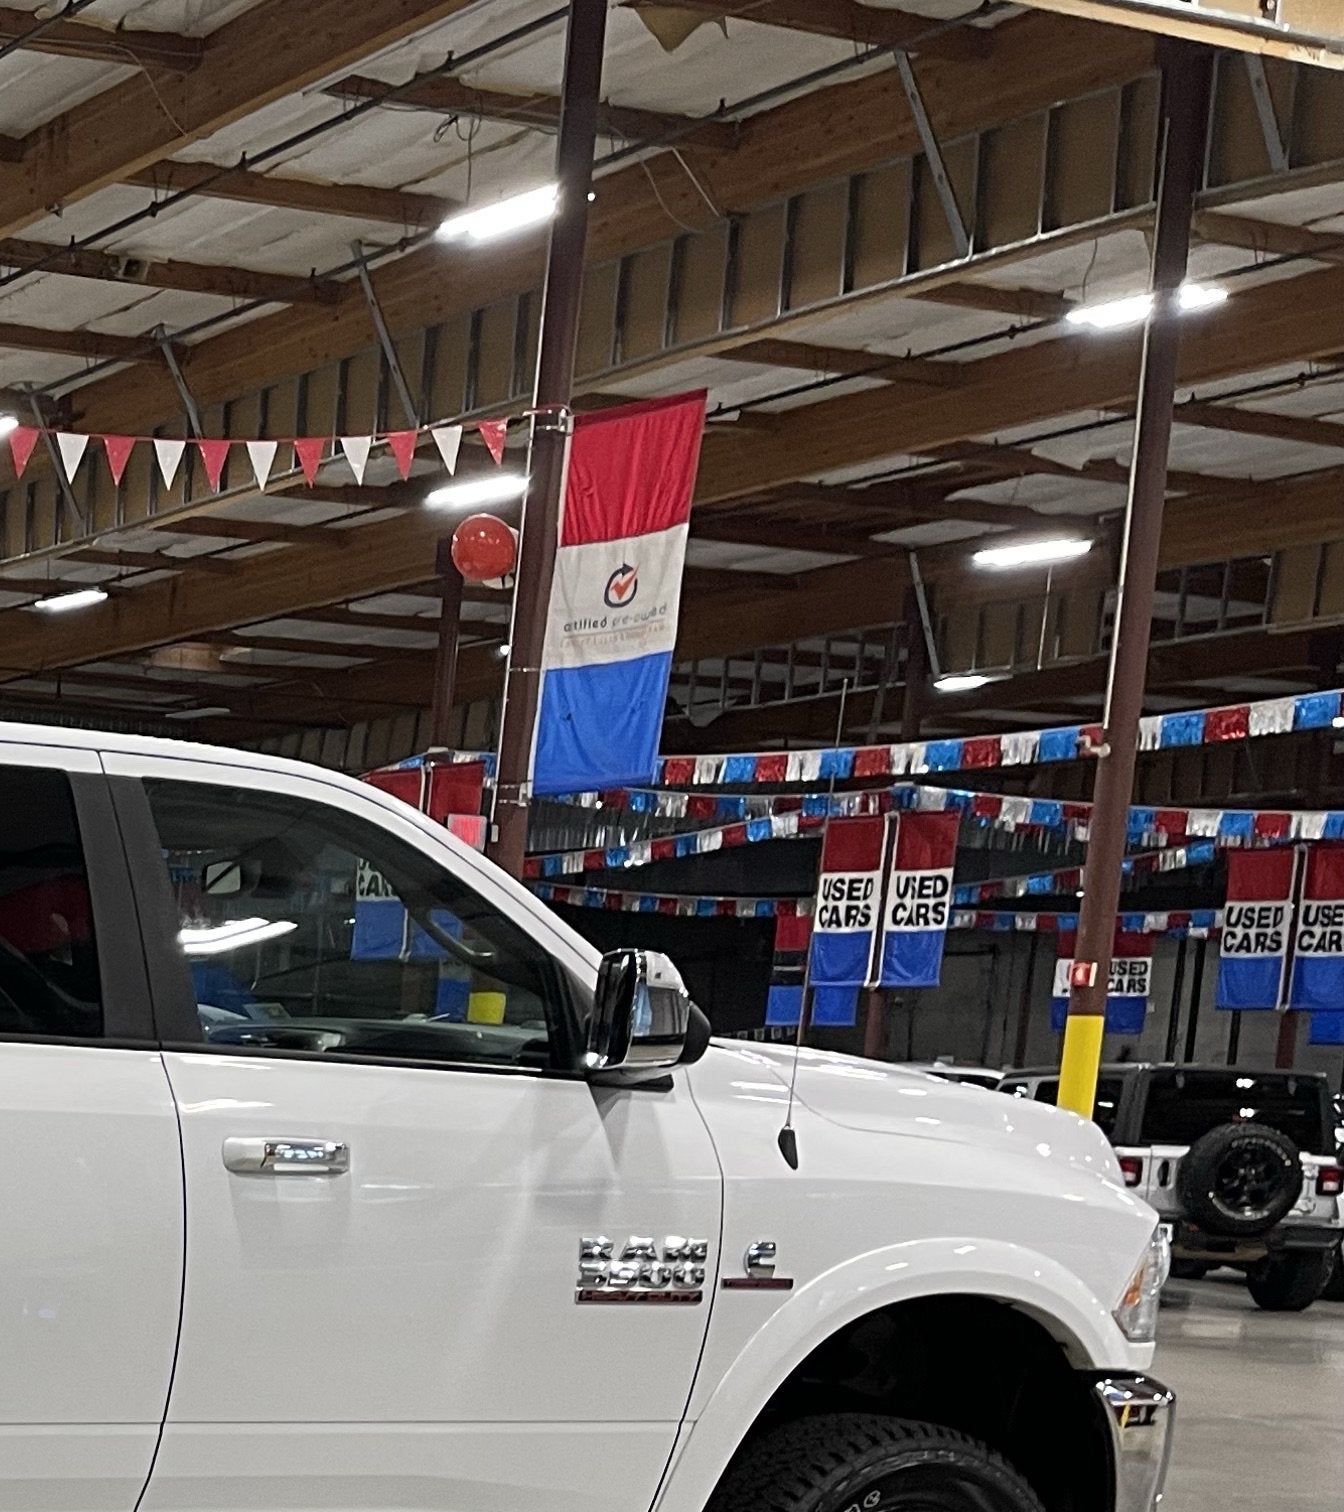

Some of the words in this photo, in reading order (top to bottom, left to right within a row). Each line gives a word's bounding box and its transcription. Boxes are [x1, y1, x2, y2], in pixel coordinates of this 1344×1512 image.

[822, 878, 874, 901] USED
[818, 904, 872, 928] CARS
[892, 901, 946, 927] CARS
[1225, 906, 1284, 929] USED
[1223, 931, 1282, 953] CARS
[1109, 961, 1148, 976] USED
[1108, 978, 1147, 993] CARS
[579, 1235, 708, 1263] RAM
